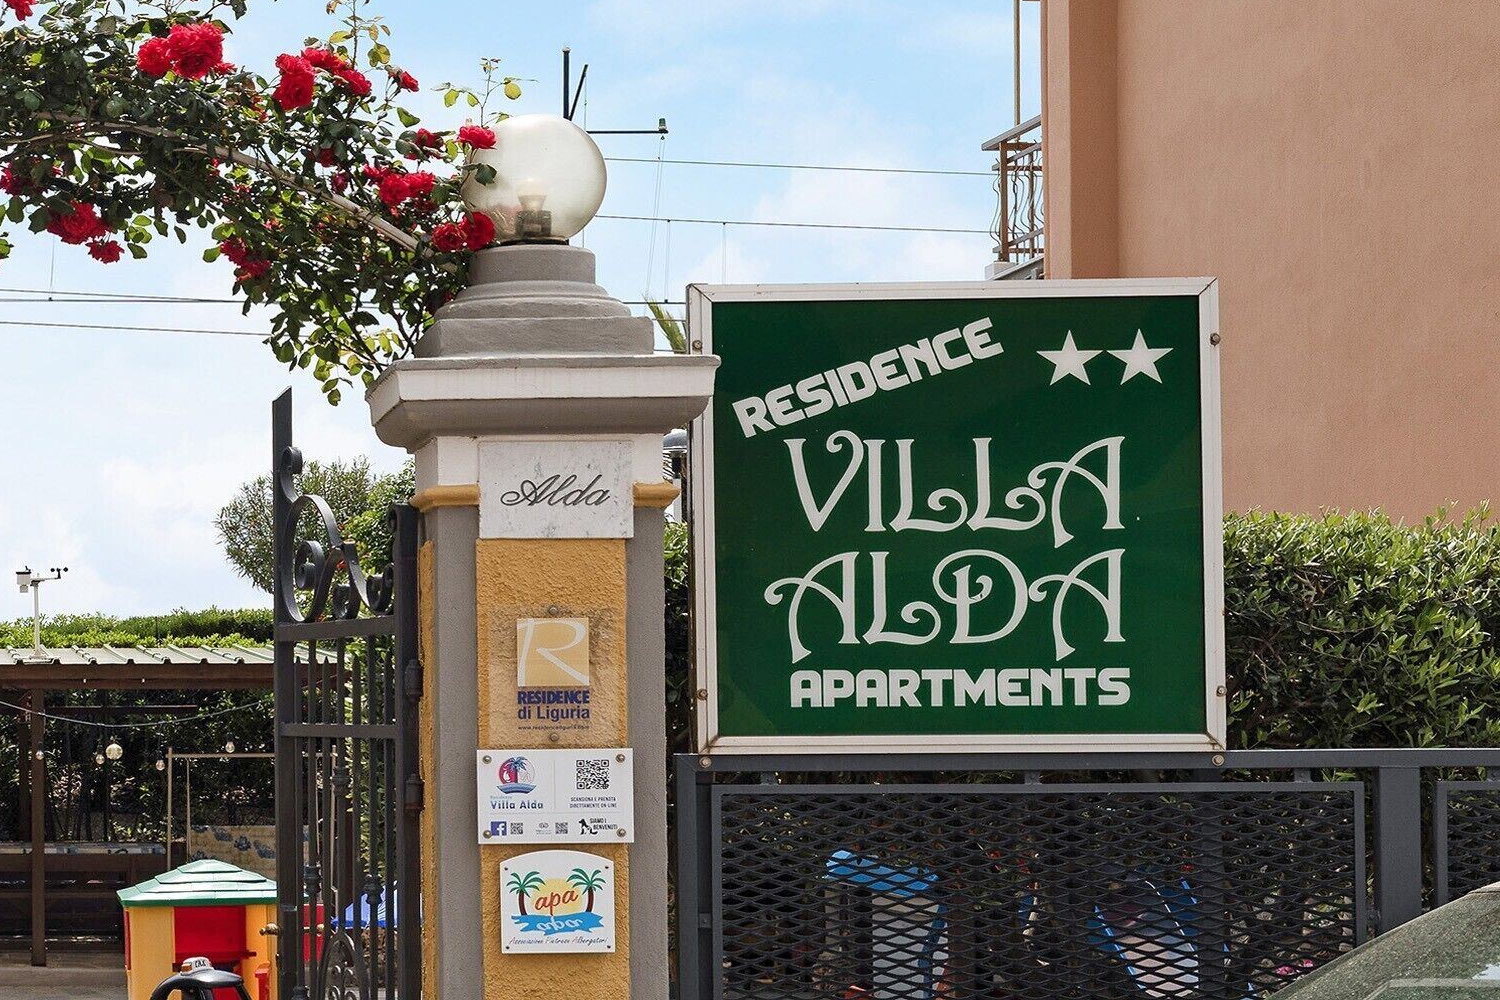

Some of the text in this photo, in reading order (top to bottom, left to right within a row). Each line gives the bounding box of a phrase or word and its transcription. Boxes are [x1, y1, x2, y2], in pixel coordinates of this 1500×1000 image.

[732, 317, 1004, 438] RESIDENCE
[500, 474, 610, 506] Alda
[783, 430, 1126, 548] VILLA
[764, 548, 1126, 664] ALDA
[517, 690, 590, 705] RESIDENCE
[789, 667, 1131, 708] APARTMENTS
[517, 705, 590, 722] di Liguria
[491, 801, 543, 810] Villa Alda
[535, 890, 579, 916] apa
